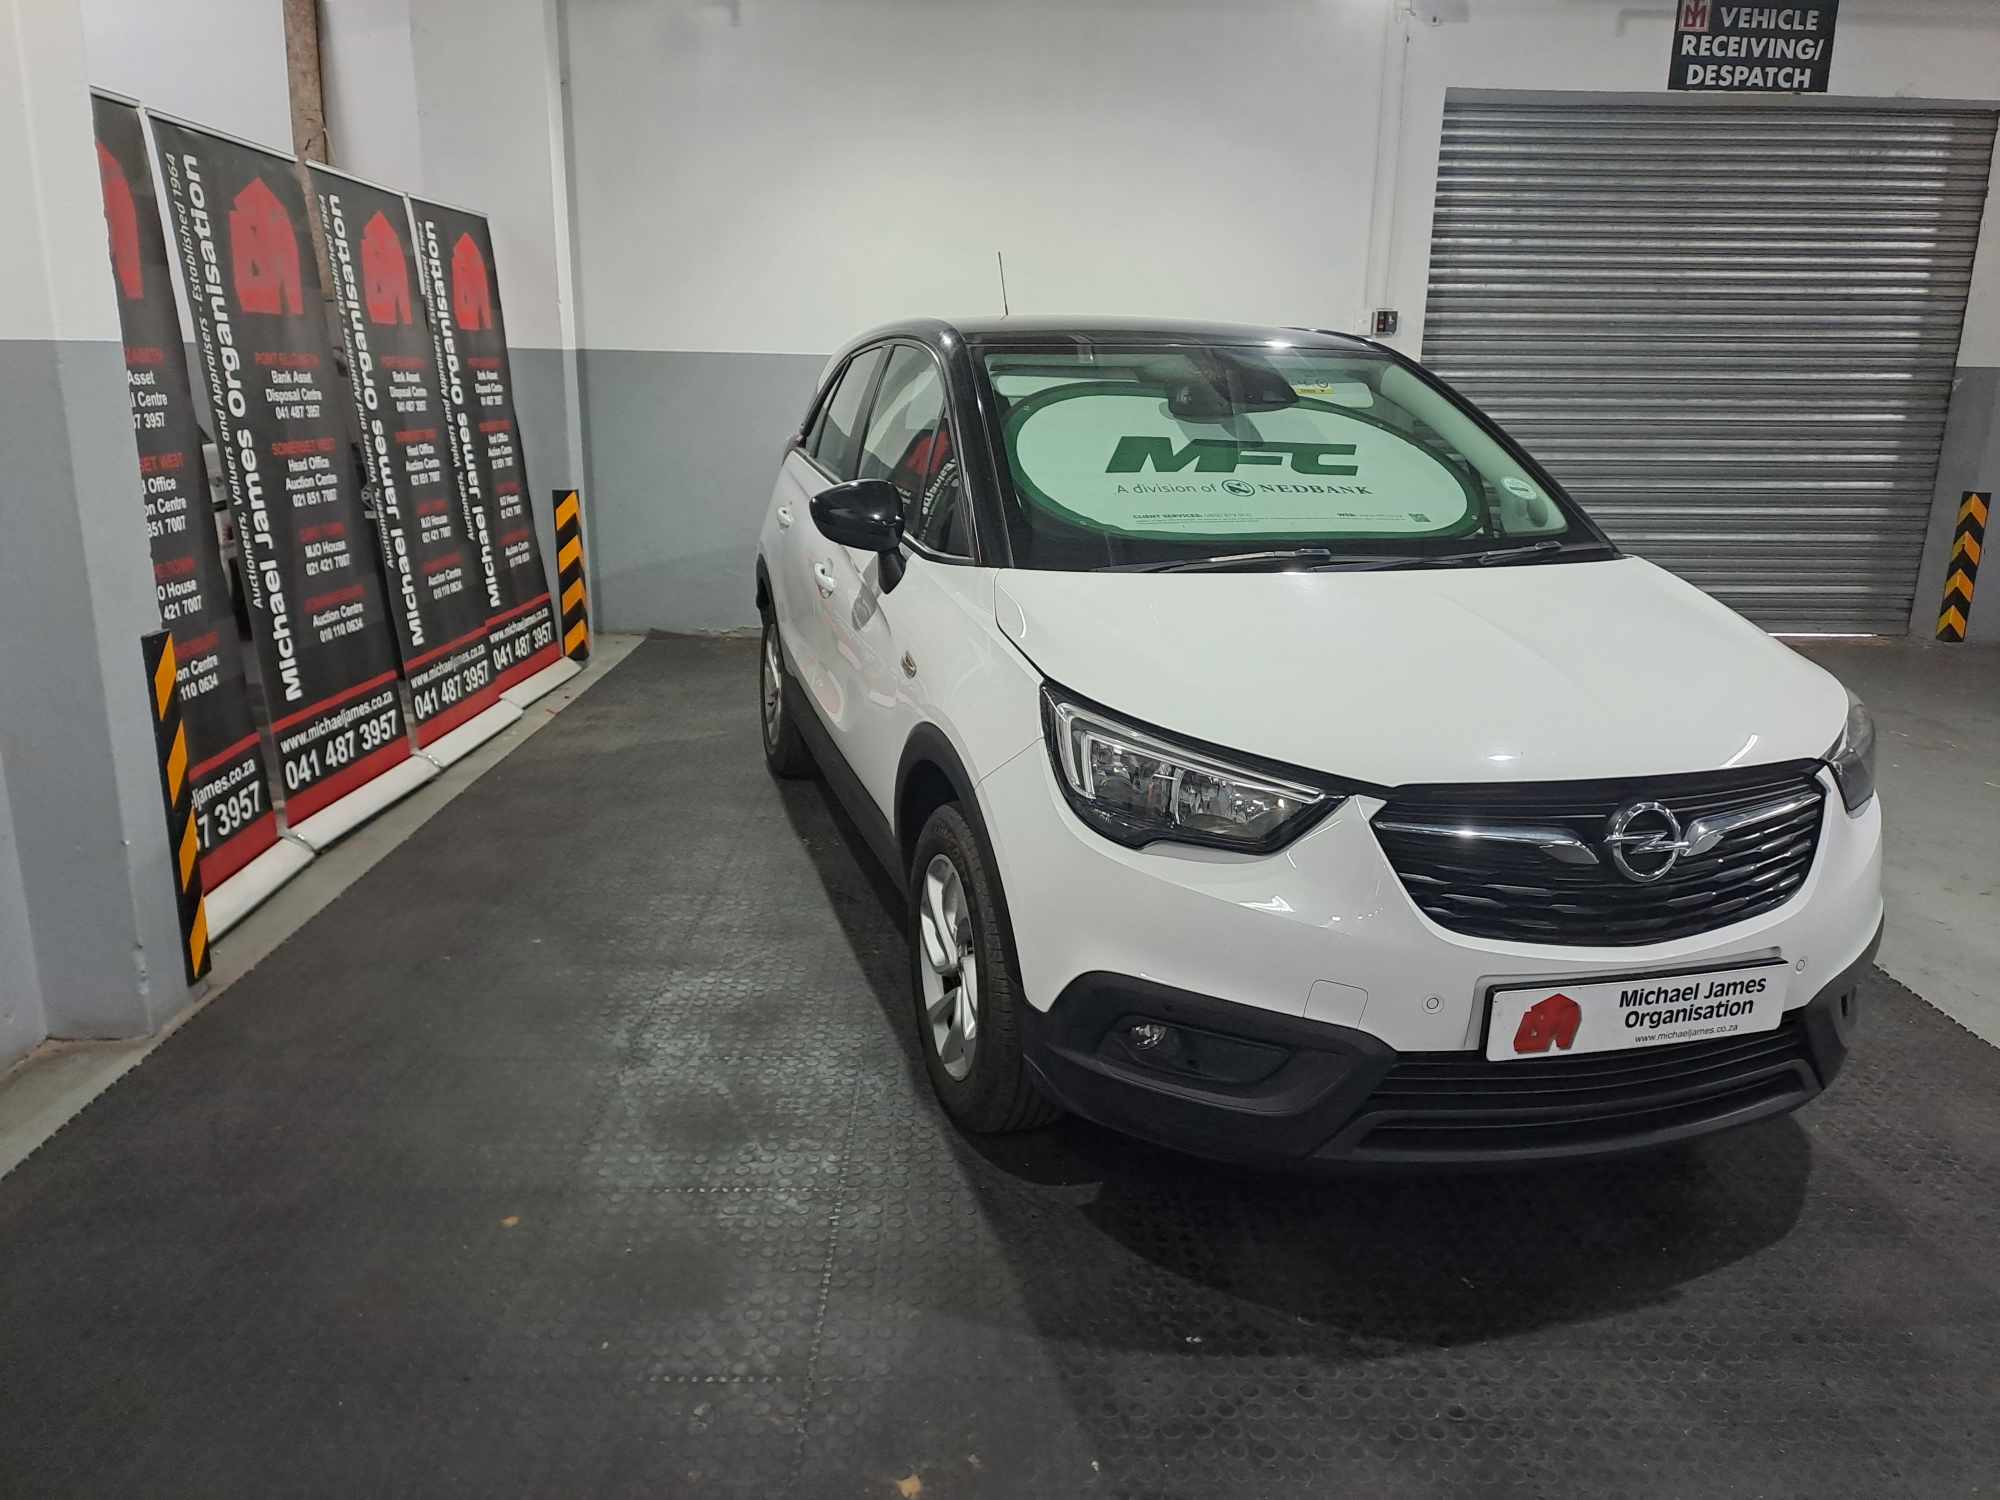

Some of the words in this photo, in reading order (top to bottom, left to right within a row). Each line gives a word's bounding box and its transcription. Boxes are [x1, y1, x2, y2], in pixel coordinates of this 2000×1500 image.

[1720, 7, 1819, 30] VEHICLE
[1681, 35, 1824, 61] RECEIVING/
[1686, 64, 1812, 88] DESPATCH
[165, 152, 183, 197] 1964
[174, 201, 203, 302] Established
[183, 154, 246, 418] Organisation
[329, 194, 378, 410] Organisation
[425, 221, 464, 405] Organisation
[127, 370, 155, 385] Asset
[199, 317, 224, 406] Appraisers
[137, 391, 168, 407] Centre
[144, 412, 165, 428] 3957
[216, 408, 230, 442] and
[225, 446, 243, 506] Valuers
[371, 419, 400, 520] James
[457, 412, 481, 499] James
[1105, 436, 1358, 476] MFC
[148, 476, 176, 493] Office
[157, 496, 187, 514] Centre
[237, 428, 274, 549] James
[1117, 484, 1129, 494] A
[1133, 483, 1196, 494] division
[1201, 483, 1217, 493] of
[1257, 484, 1374, 495] NEDBANK
[238, 511, 264, 609] Auctioneers,
[472, 506, 500, 607] Michael
[166, 579, 197, 598] House
[390, 528, 425, 647] Michael
[164, 602, 181, 621] 421
[259, 559, 303, 702] Michael
[312, 609, 340, 628] Auction
[492, 643, 513, 670] 041
[515, 633, 531, 658] 487
[532, 621, 552, 649] 3957
[414, 687, 439, 720] 041
[441, 675, 462, 704] 487
[463, 660, 489, 692] 3957
[280, 691, 393, 754] www.michaeljames.co.za
[285, 749, 321, 790] 041
[325, 730, 355, 768] 487
[359, 709, 397, 751] 3957
[214, 780, 259, 836] 3957
[1619, 983, 1700, 1008] Michael
[1704, 978, 1766, 999] James
[1625, 1000, 1754, 1029] Organisation
[1635, 1024, 1738, 1043] www.michaeljames.co.za
